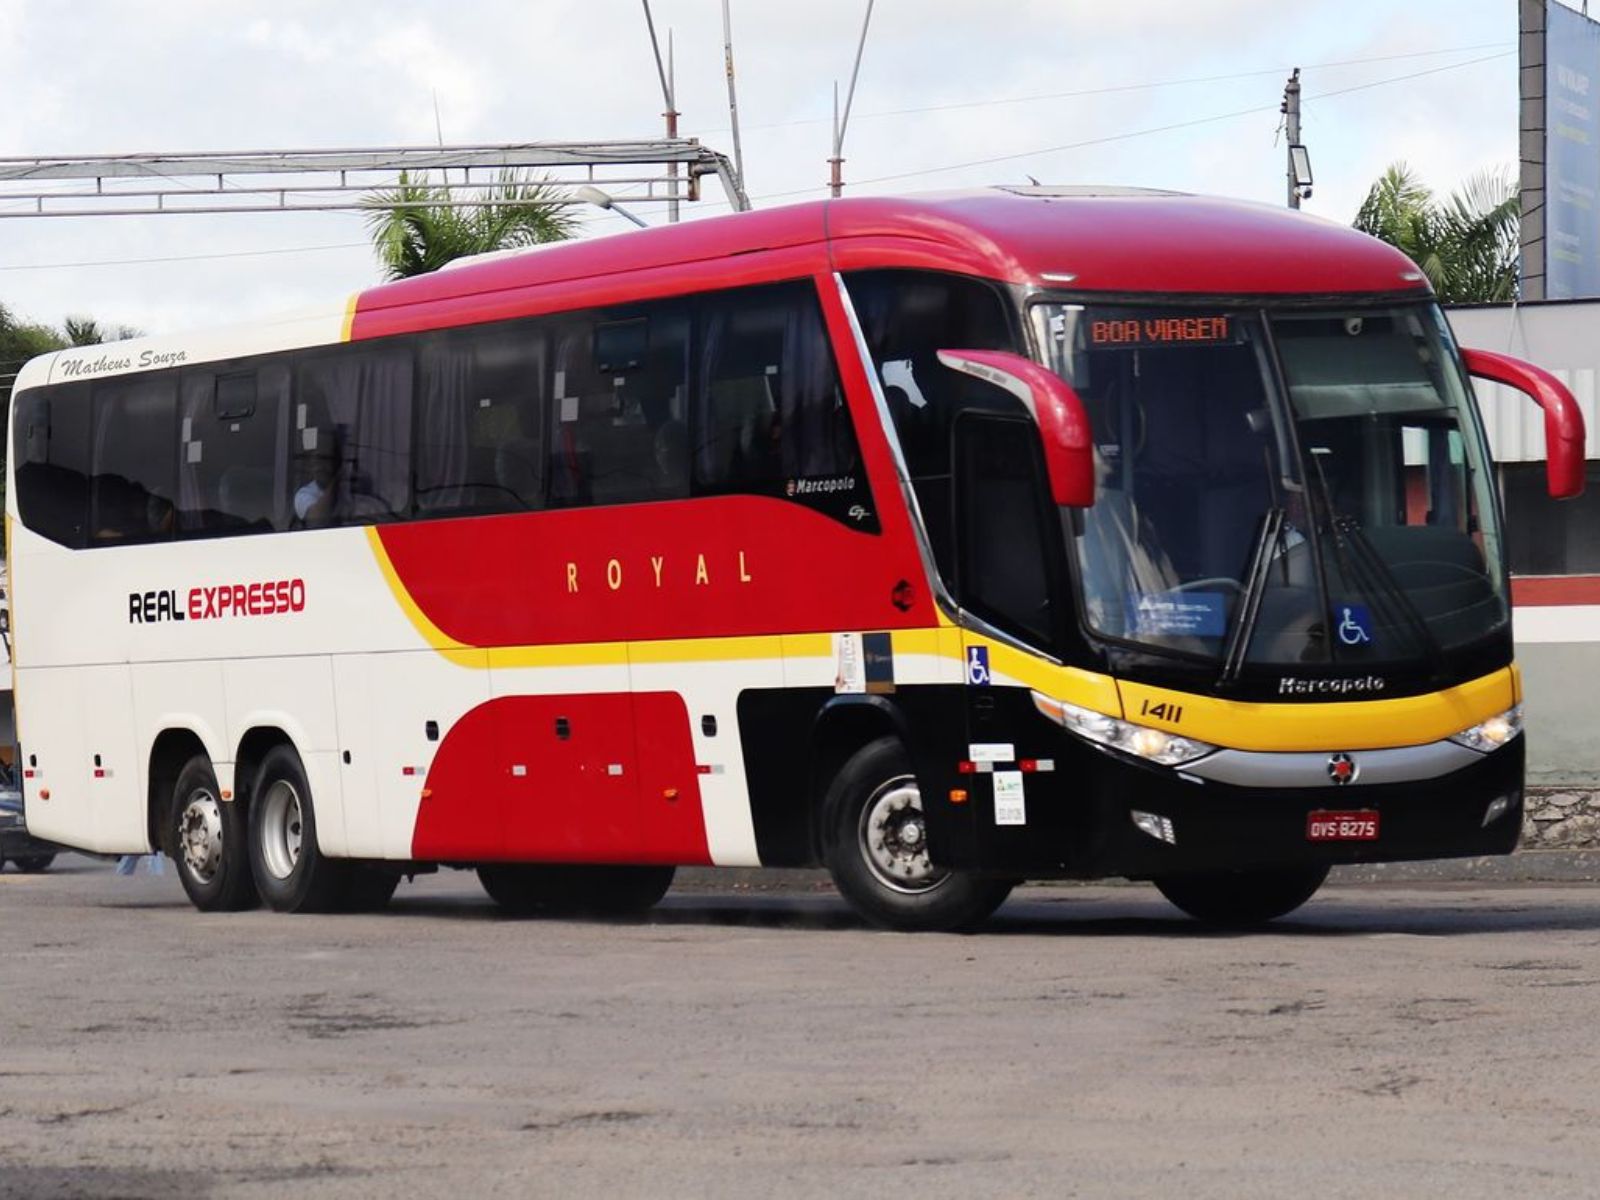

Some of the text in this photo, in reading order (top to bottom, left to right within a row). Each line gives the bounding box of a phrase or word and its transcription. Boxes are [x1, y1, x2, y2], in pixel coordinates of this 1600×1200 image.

[1092, 317, 1227, 342] BOA VIAGEM
[796, 476, 856, 494] Marcopolo
[566, 551, 752, 593] ROYAL
[129, 578, 305, 623] REAL EXPRESSO
[1278, 676, 1386, 695] Marcopolo
[1141, 698, 1183, 724] 1411
